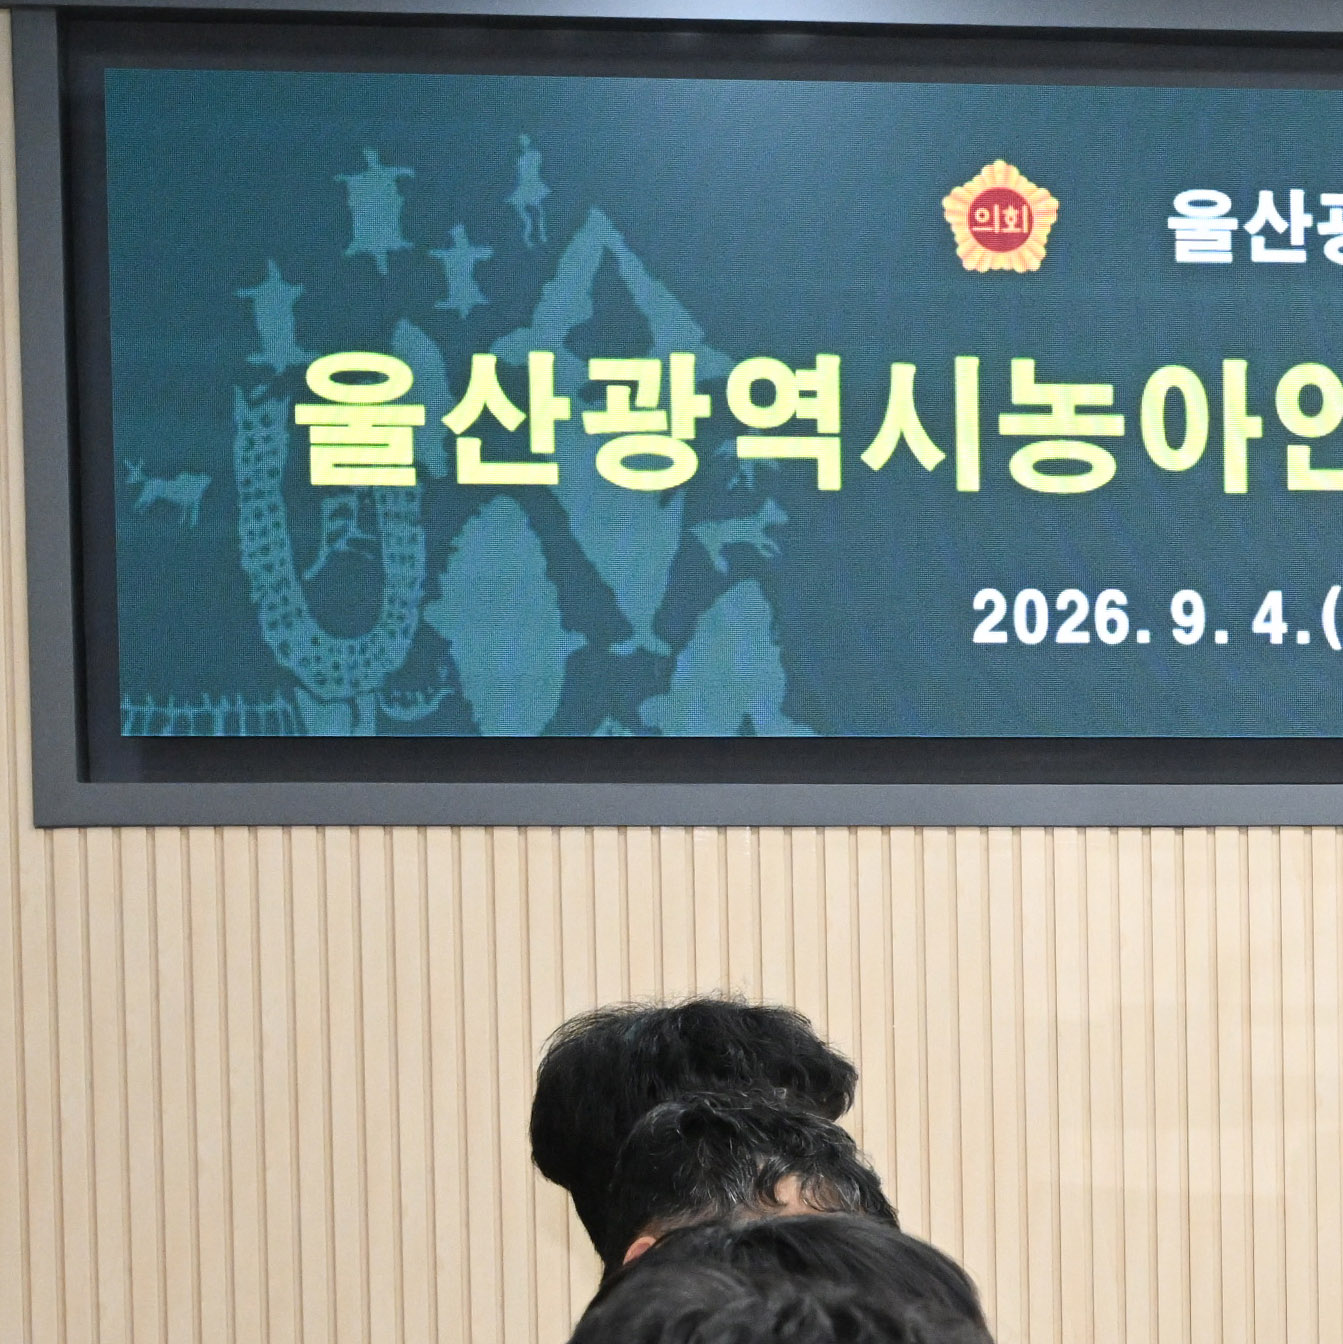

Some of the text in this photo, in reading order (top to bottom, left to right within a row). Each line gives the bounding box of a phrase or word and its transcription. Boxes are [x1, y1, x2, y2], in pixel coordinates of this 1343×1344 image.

[972, 204, 1029, 234] 의회
[972, 588, 1150, 645] 2026.
[1170, 589, 1229, 646] 9.
